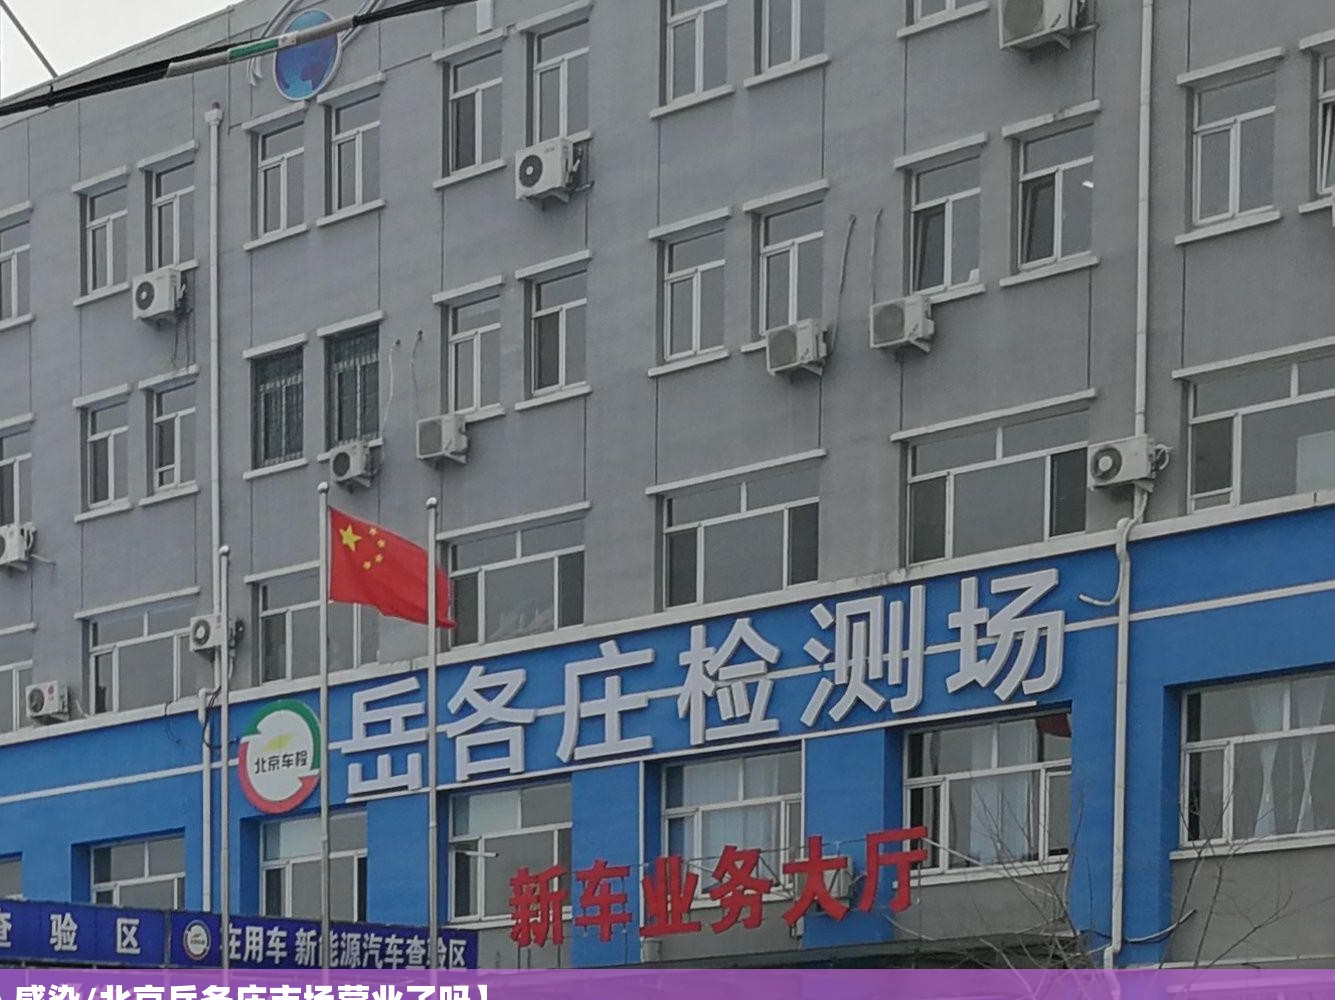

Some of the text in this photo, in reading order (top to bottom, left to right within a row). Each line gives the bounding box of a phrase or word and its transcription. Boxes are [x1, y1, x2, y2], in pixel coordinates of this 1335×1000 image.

[339, 568, 1067, 799] 岳各庄检测场
[509, 825, 928, 949] 新车业务大厅
